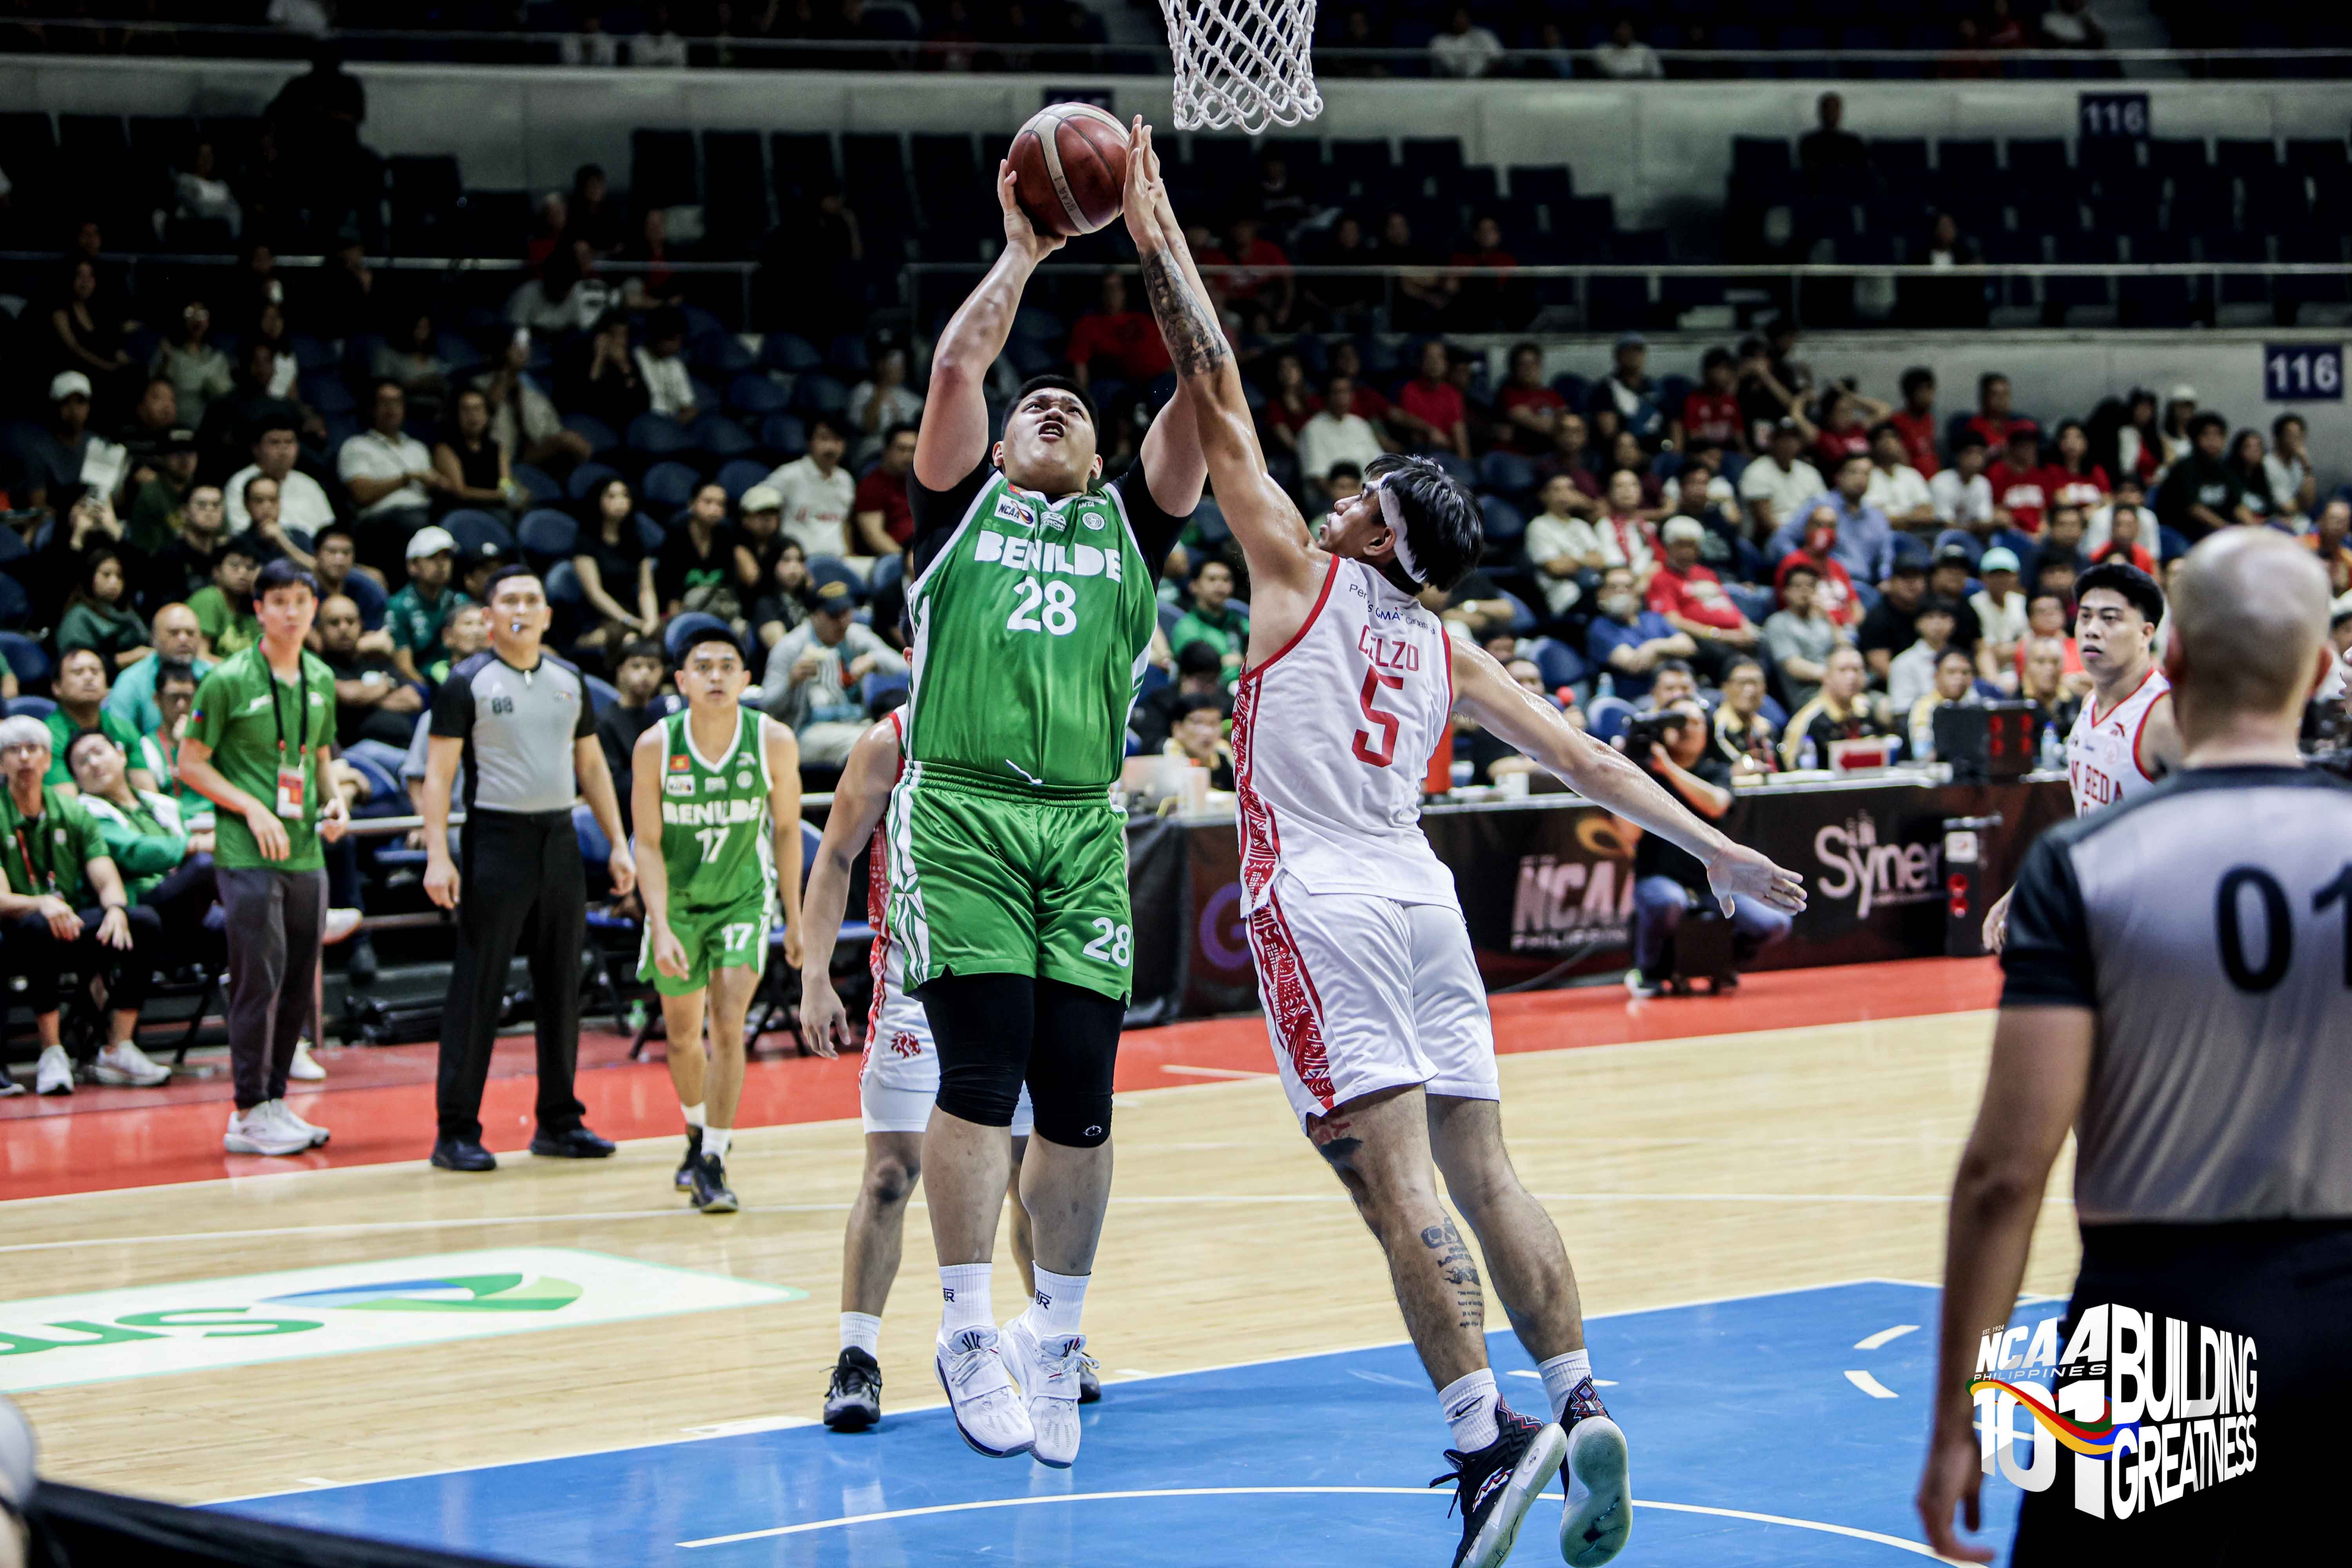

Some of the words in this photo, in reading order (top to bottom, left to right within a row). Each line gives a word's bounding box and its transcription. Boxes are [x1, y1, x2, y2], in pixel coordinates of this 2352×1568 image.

[2083, 101, 2143, 132] 116
[2268, 352, 2338, 391] 116
[998, 504, 1020, 519] NCAA
[975, 530, 1122, 584] BENILDE
[1007, 576, 1077, 636] 28
[1352, 664, 1404, 768] 5
[662, 797, 761, 826] BENILDE
[695, 827, 730, 864] 17
[721, 923, 754, 951] 17
[1082, 916, 1131, 967] 28
[2216, 862, 2352, 994] 01
